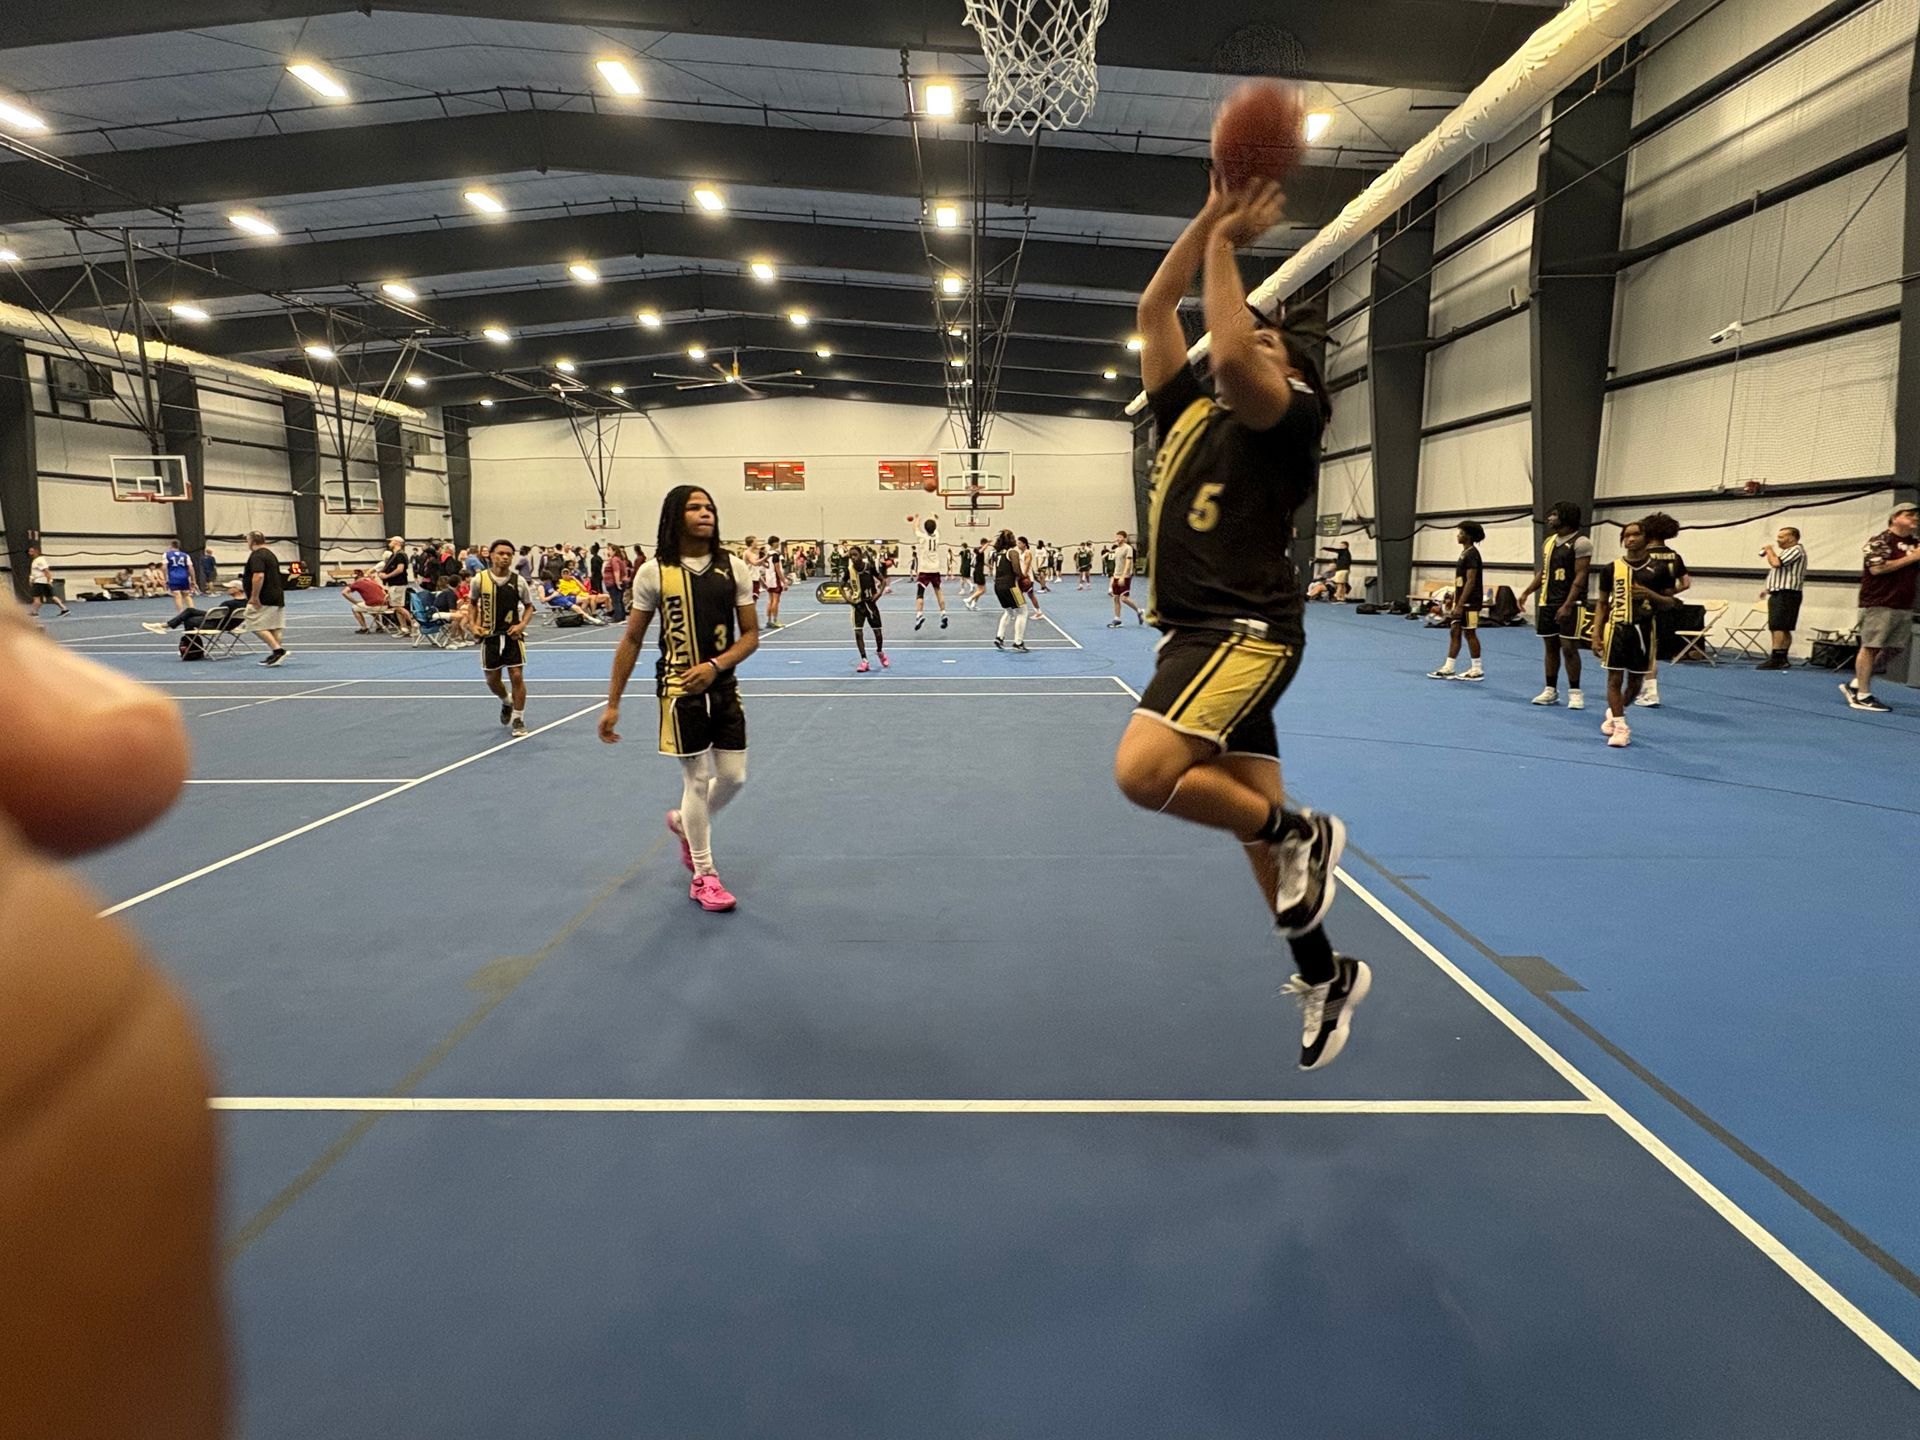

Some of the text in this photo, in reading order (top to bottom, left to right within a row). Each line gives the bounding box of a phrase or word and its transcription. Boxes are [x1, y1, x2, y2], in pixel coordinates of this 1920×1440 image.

[1189, 483, 1225, 532] 5
[928, 540, 937, 552] 11
[170, 556, 185, 567] 14
[1554, 568, 1566, 581] 13
[504, 609, 514, 624] 4
[714, 623, 728, 651] 3
